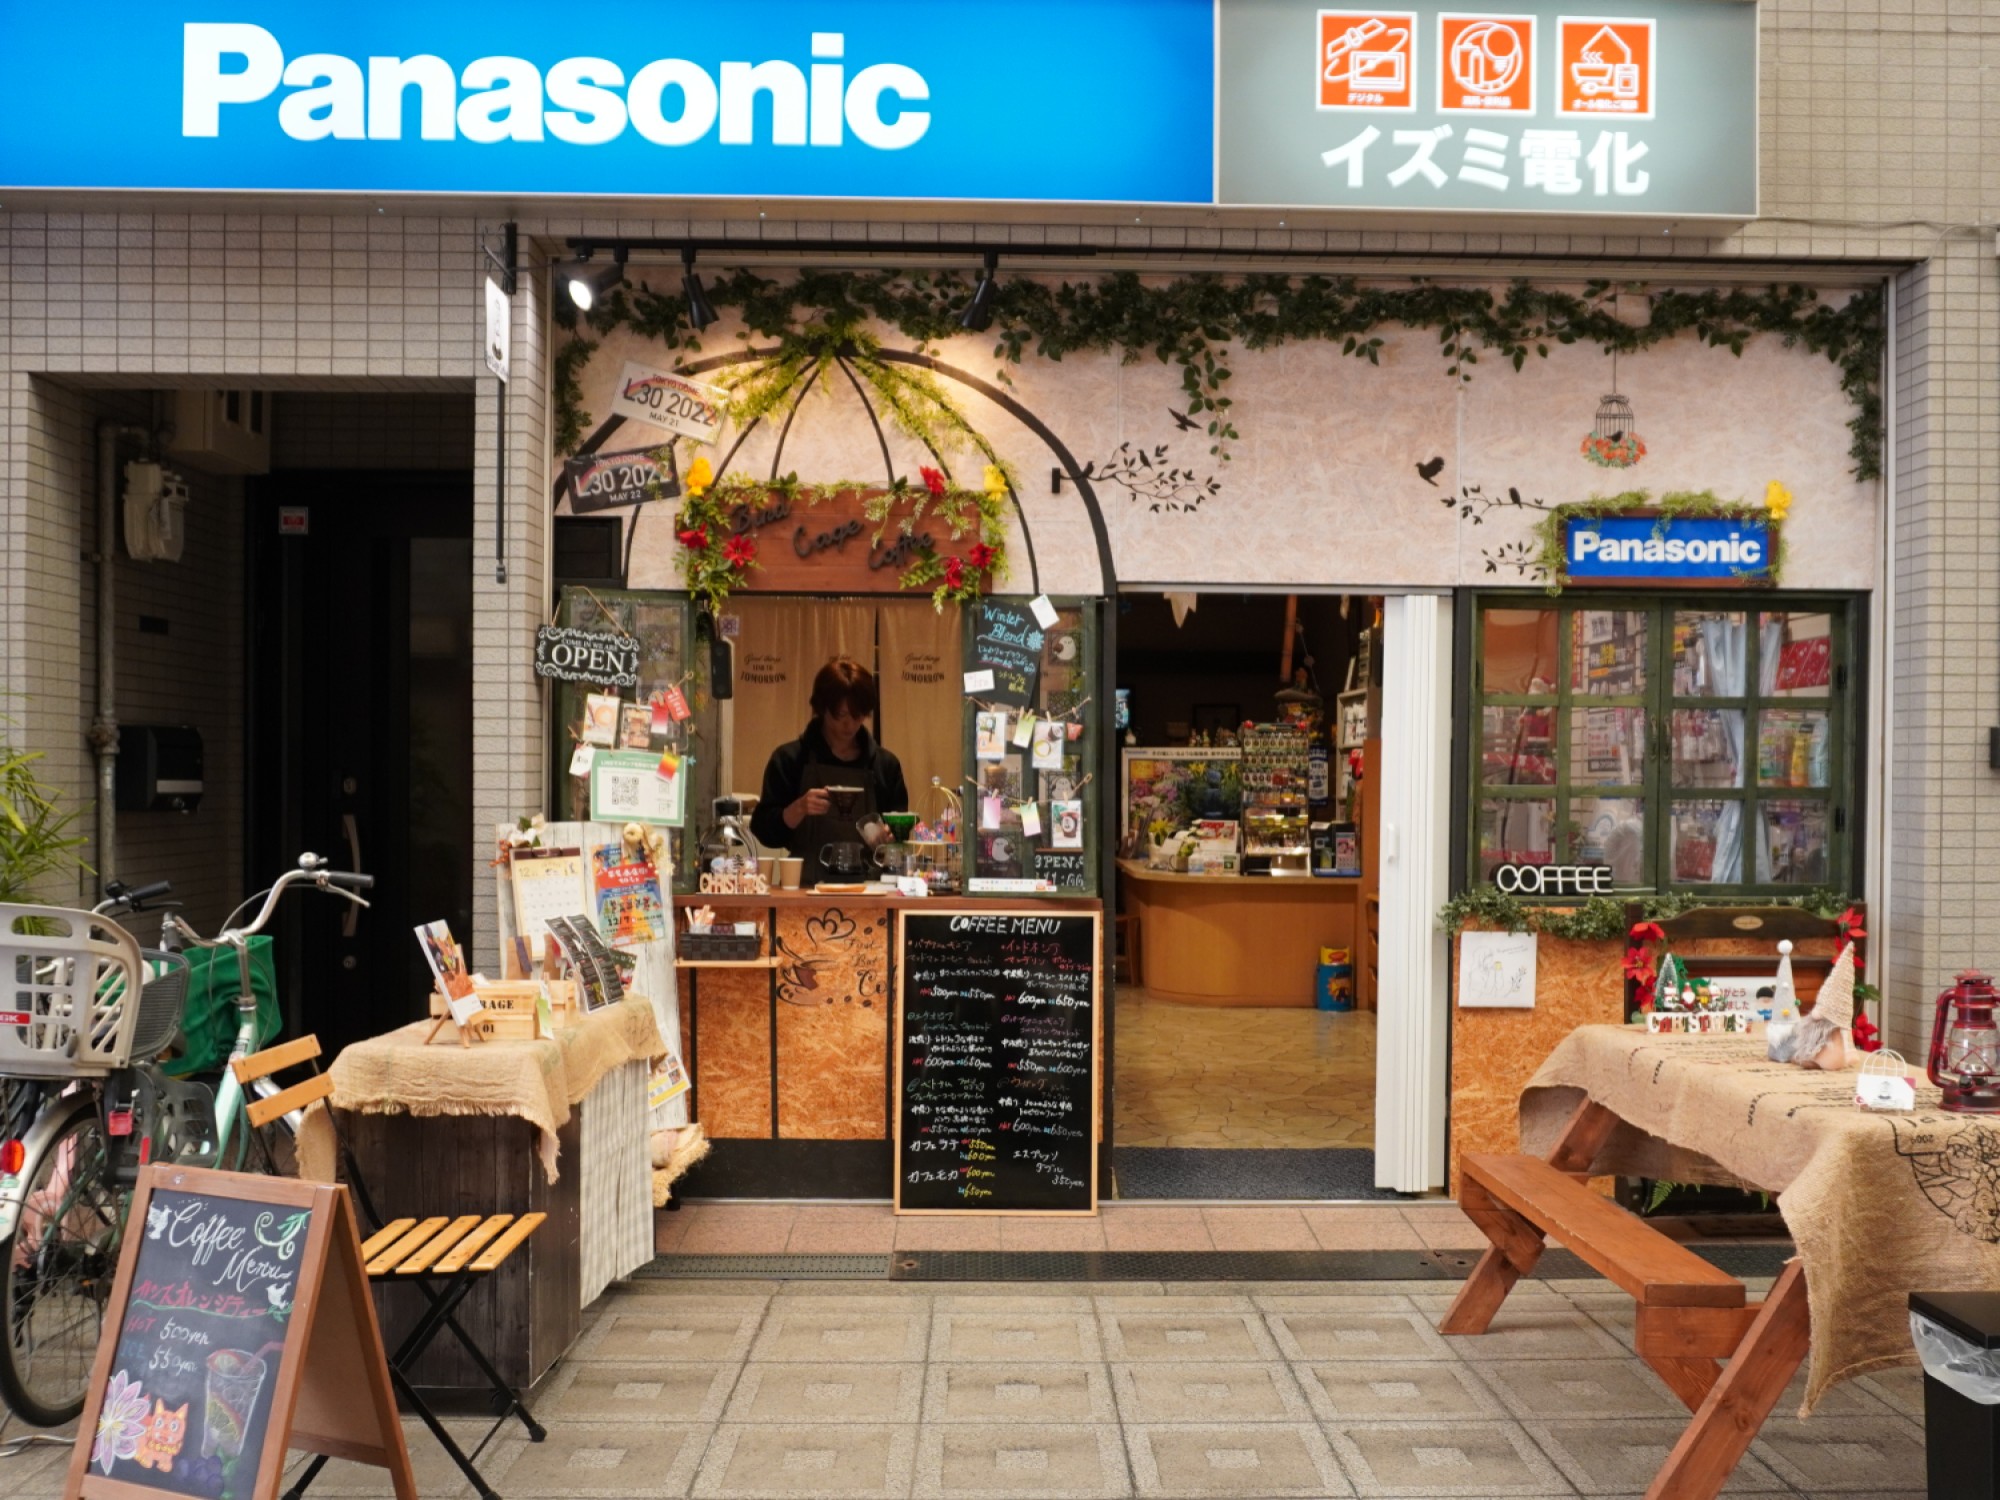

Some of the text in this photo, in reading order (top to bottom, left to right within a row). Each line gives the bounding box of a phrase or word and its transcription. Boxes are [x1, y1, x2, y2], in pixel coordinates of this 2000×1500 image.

[182, 22, 932, 150] Panasonic
[1320, 123, 1651, 197] イズミ電化
[652, 373, 700, 397] TOKYO DOME
[623, 377, 715, 428] L30 2022
[649, 411, 680, 428] MAY 21
[594, 453, 646, 469] TOKYO DOME
[574, 469, 617, 498] L30
[608, 490, 642, 503] MAY 22
[792, 519, 865, 559] Cage
[1573, 530, 1762, 566] Panasonic
[990, 622, 1031, 648] Blend
[551, 643, 626, 674] OPEN
[1496, 864, 1614, 894] COFFEE
[950, 915, 1062, 935] COFFEE MENU
[1648, 1012, 1747, 1034] CHRISTMAS
[167, 1202, 247, 1266] Coffee
[212, 1246, 294, 1293] Menu
[125, 1315, 210, 1346] HOT 500yen
[120, 1339, 198, 1376] ICE 550yen
